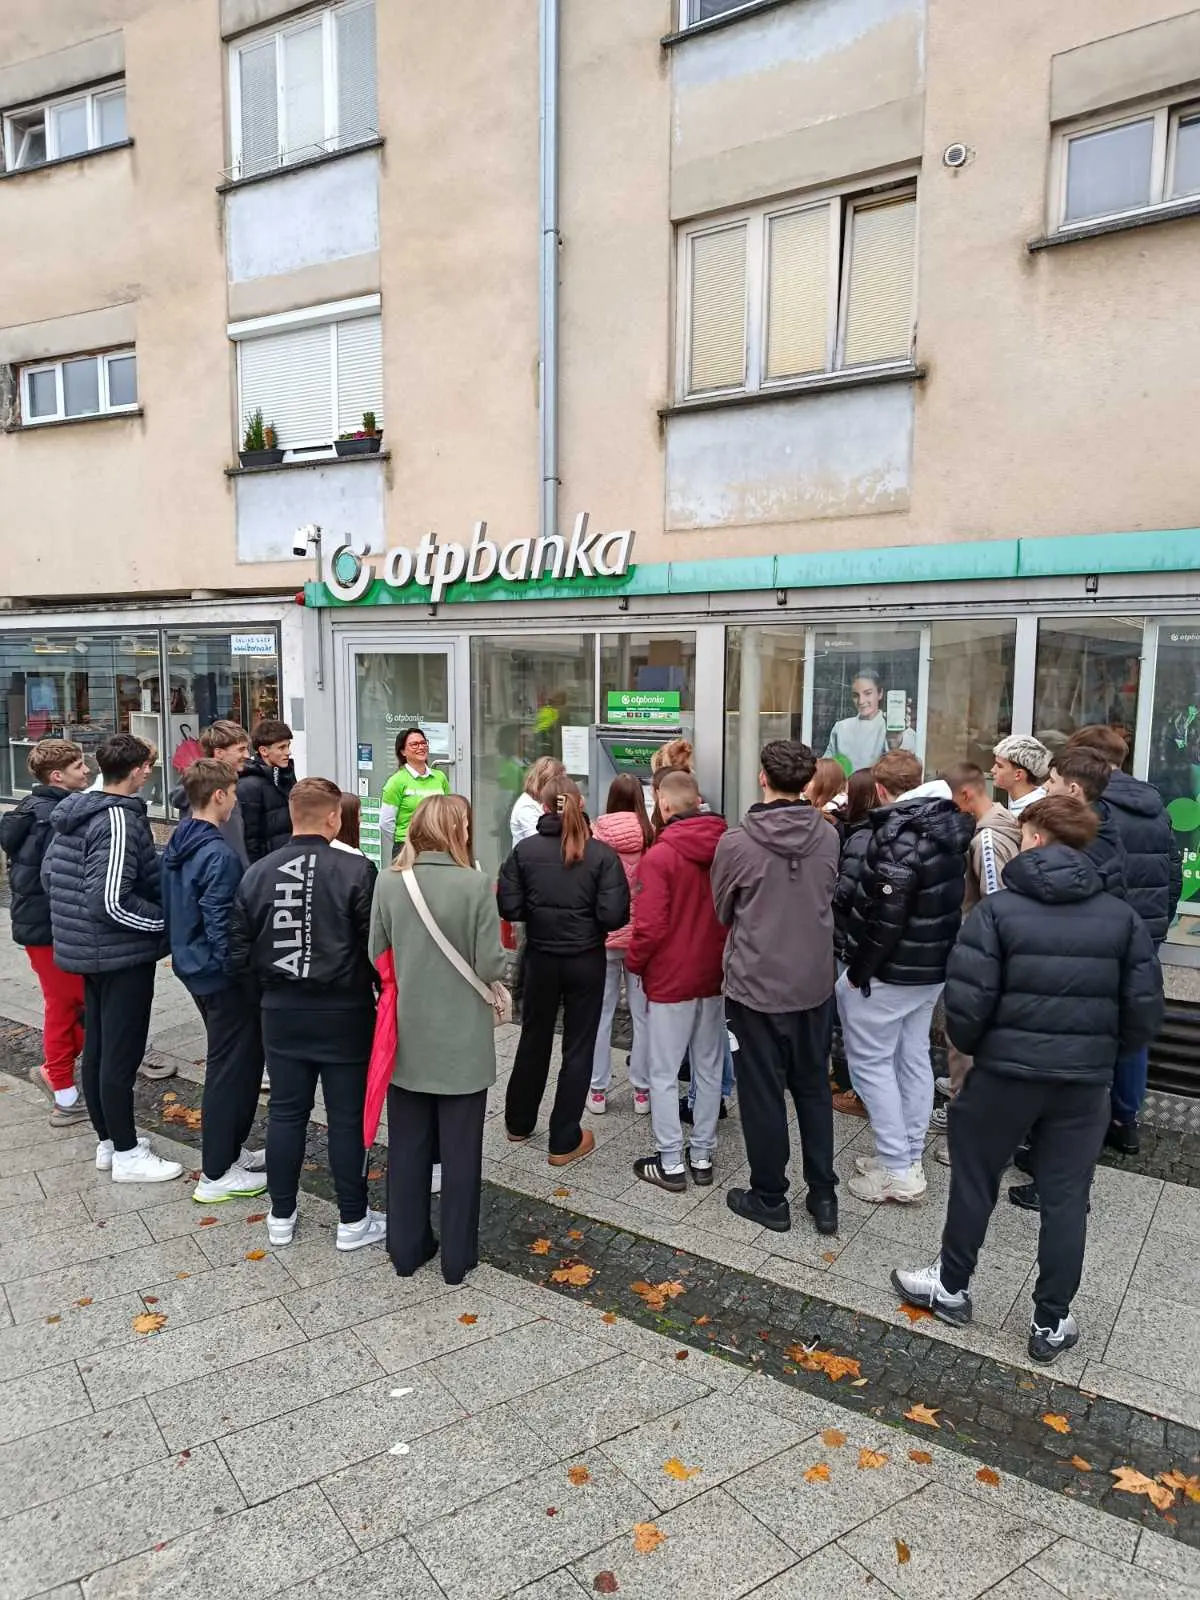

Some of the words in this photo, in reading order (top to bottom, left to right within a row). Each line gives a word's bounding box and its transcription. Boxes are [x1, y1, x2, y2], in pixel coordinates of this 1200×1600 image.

[384, 512, 636, 602] otpbanka
[272, 854, 306, 977] ALPHA
[304, 869, 314, 961] INDUSTRIES
